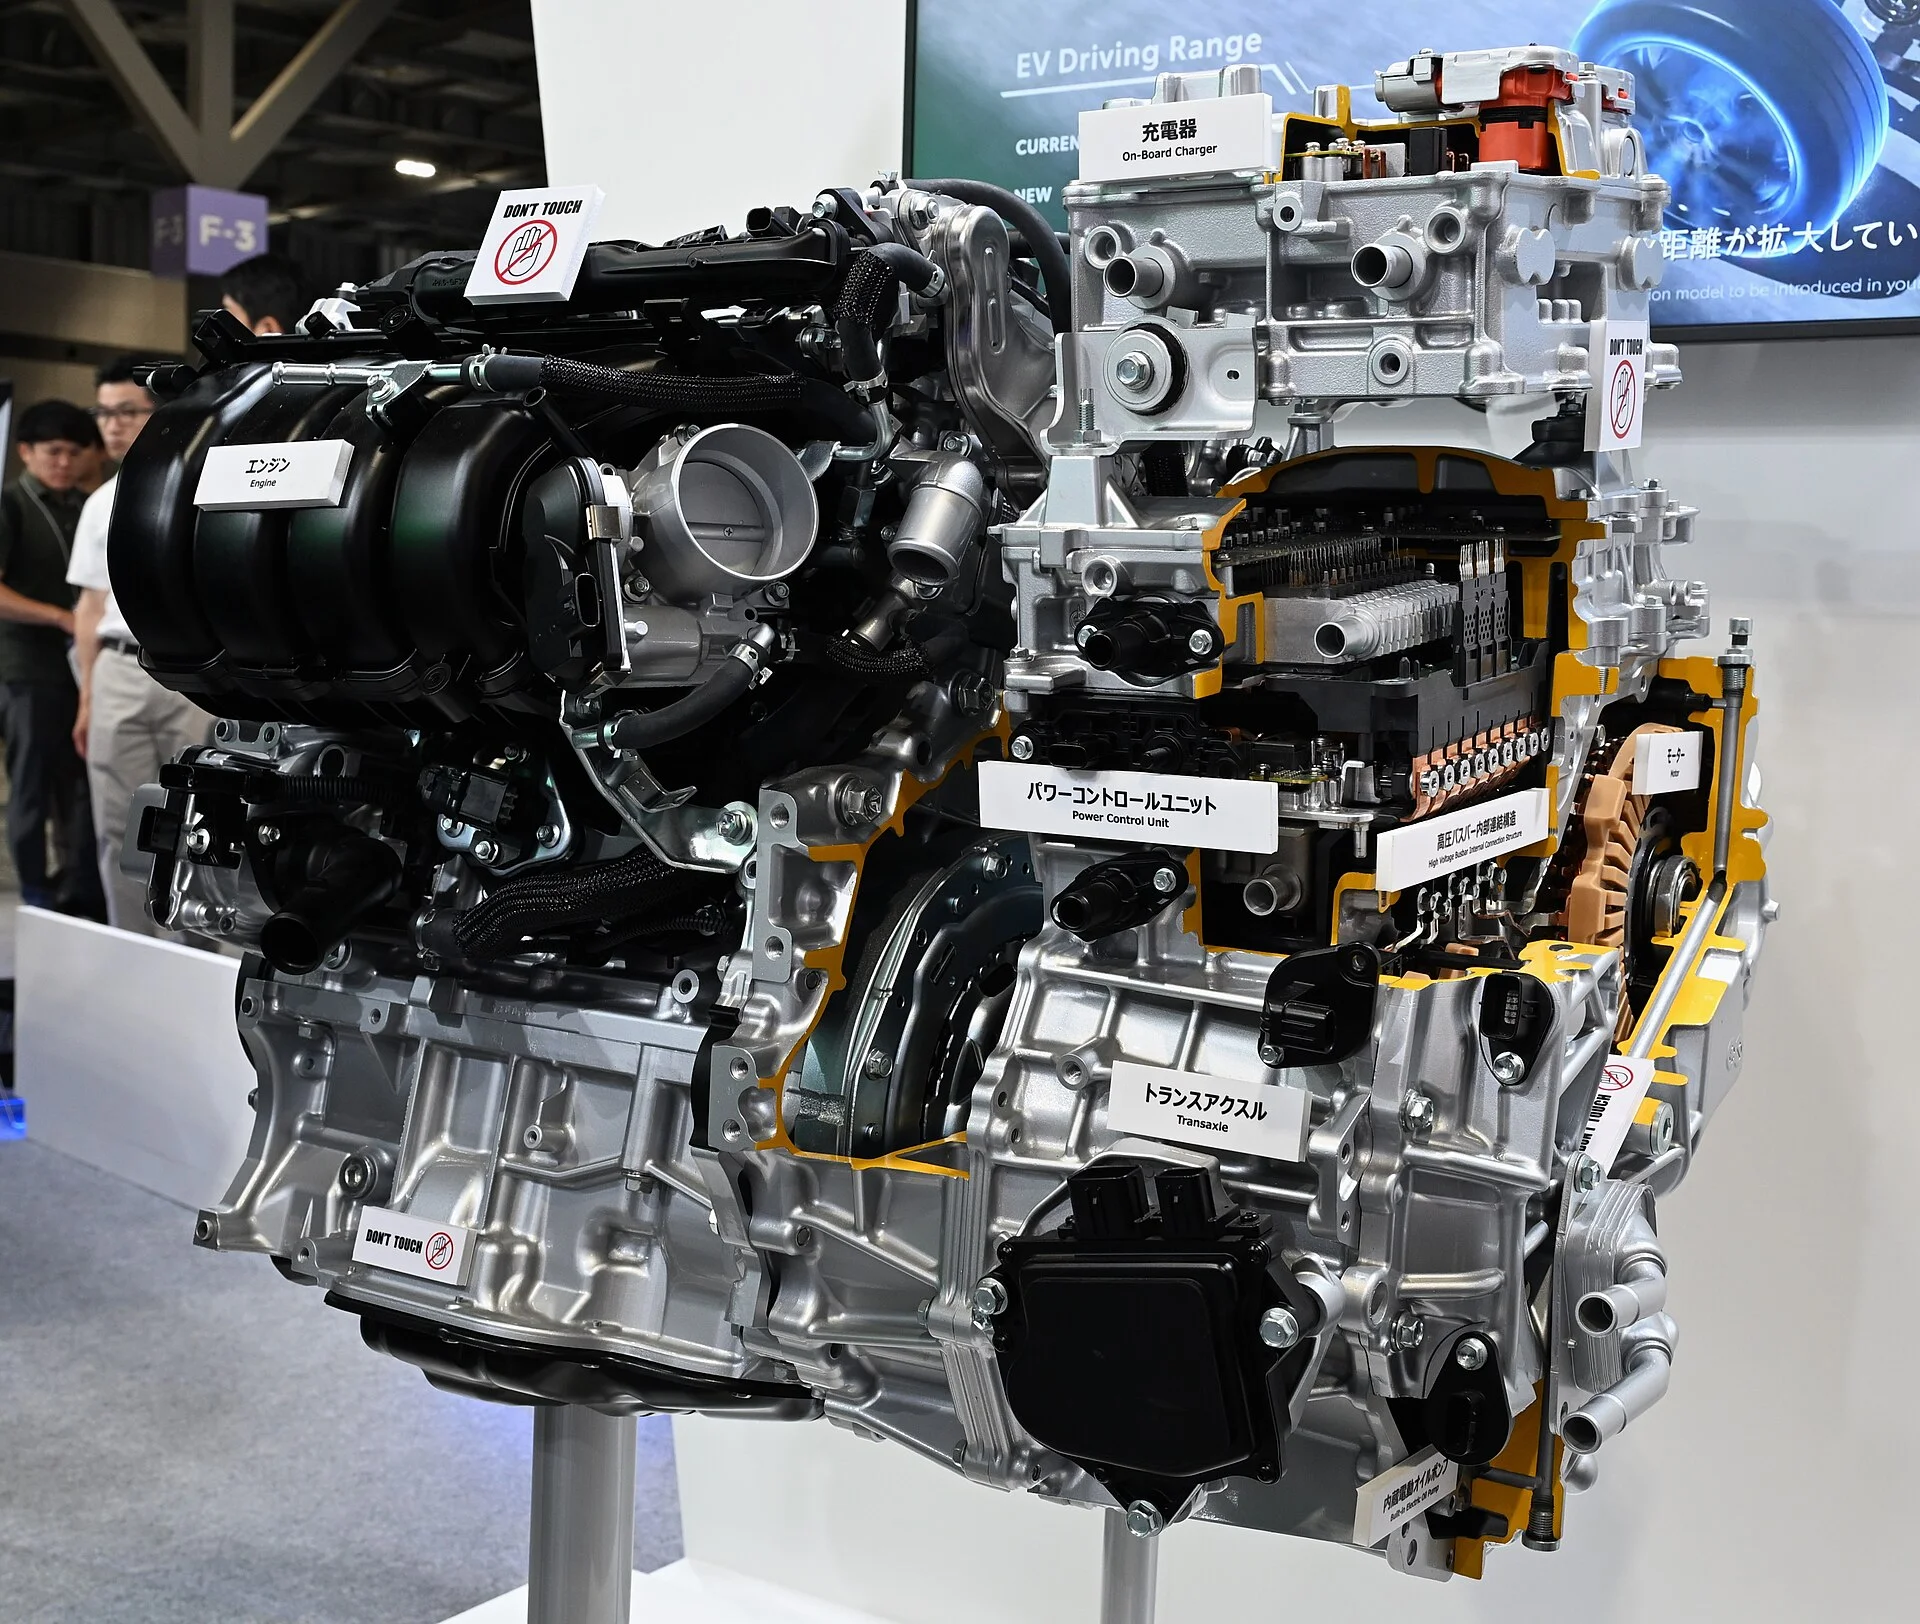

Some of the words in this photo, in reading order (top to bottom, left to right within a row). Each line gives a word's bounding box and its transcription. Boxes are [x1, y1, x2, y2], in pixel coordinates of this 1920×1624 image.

[1017, 51, 1051, 78] EV
[1058, 41, 1159, 74] Driving
[1169, 32, 1262, 62] Range
[1141, 118, 1197, 143] 充電器
[1122, 147, 1172, 162] On-Board
[1175, 144, 1218, 158] Charger
[1014, 186, 1052, 204] NEW
[503, 203, 539, 218] DON'T
[541, 200, 583, 215] TOUCH
[199, 214, 256, 252] F-3
[1675, 283, 1724, 300] model
[1730, 285, 1747, 299] to
[1749, 281, 1770, 298] be
[1774, 279, 1862, 297] introduced
[1867, 278, 1882, 293] in
[1626, 338, 1643, 356] TOUCH
[245, 457, 291, 474] エンジン
[250, 478, 277, 489] Engine
[1027, 781, 1217, 816] パワーコントロールユニット
[1072, 810, 1104, 822] Power
[1106, 813, 1144, 826] Control
[1147, 816, 1170, 828] Unit
[1145, 1082, 1268, 1121] トランスアクスル
[1588, 1093, 1612, 1123] TOUCH
[1176, 1114, 1229, 1133] Transaxle
[365, 1228, 391, 1247] DON'T
[393, 1235, 423, 1254] TOUCH
